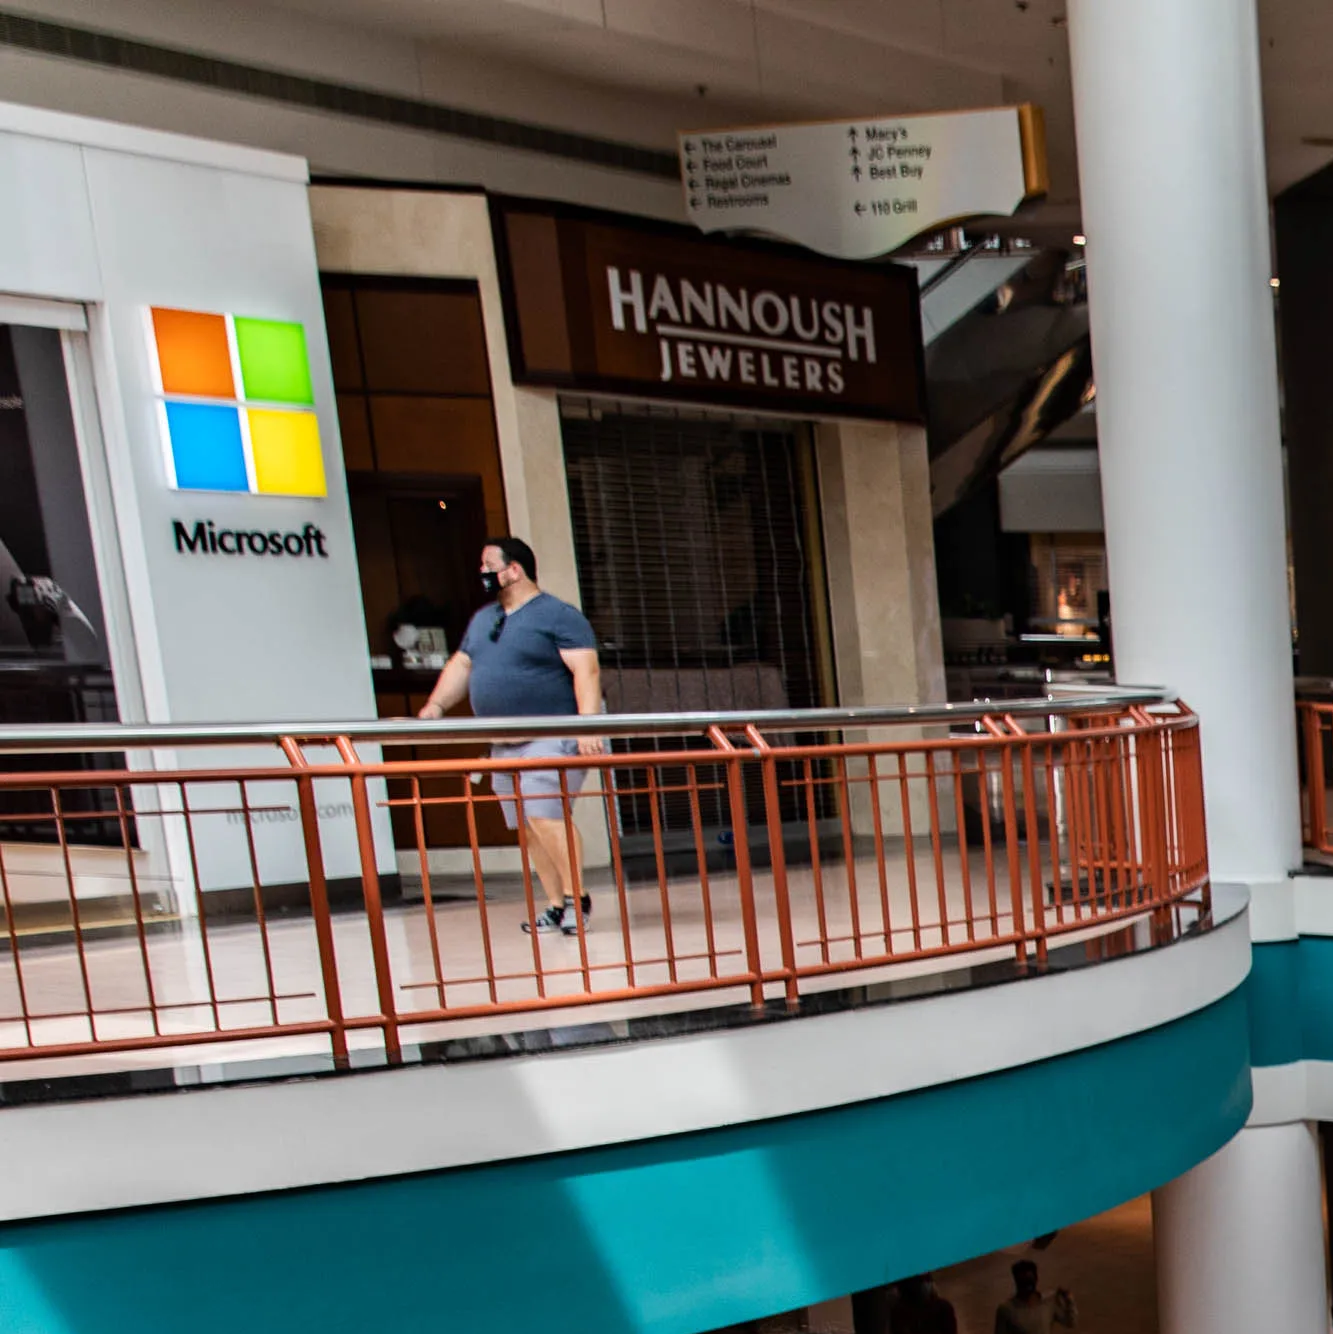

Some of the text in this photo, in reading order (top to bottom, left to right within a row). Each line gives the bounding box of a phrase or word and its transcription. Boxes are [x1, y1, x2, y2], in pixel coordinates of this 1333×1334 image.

[865, 126, 908, 143] Macy's
[701, 135, 777, 152] The Carousel
[867, 144, 932, 161] JC Penney
[703, 155, 768, 171] Food Court
[869, 163, 924, 180] Best Buy
[705, 173, 791, 192] Regal Cinemas
[707, 194, 769, 210] Restrooms
[607, 265, 877, 364] HANNOUSH
[660, 338, 844, 394] JEWELERS
[172, 518, 329, 558] Microsoft
